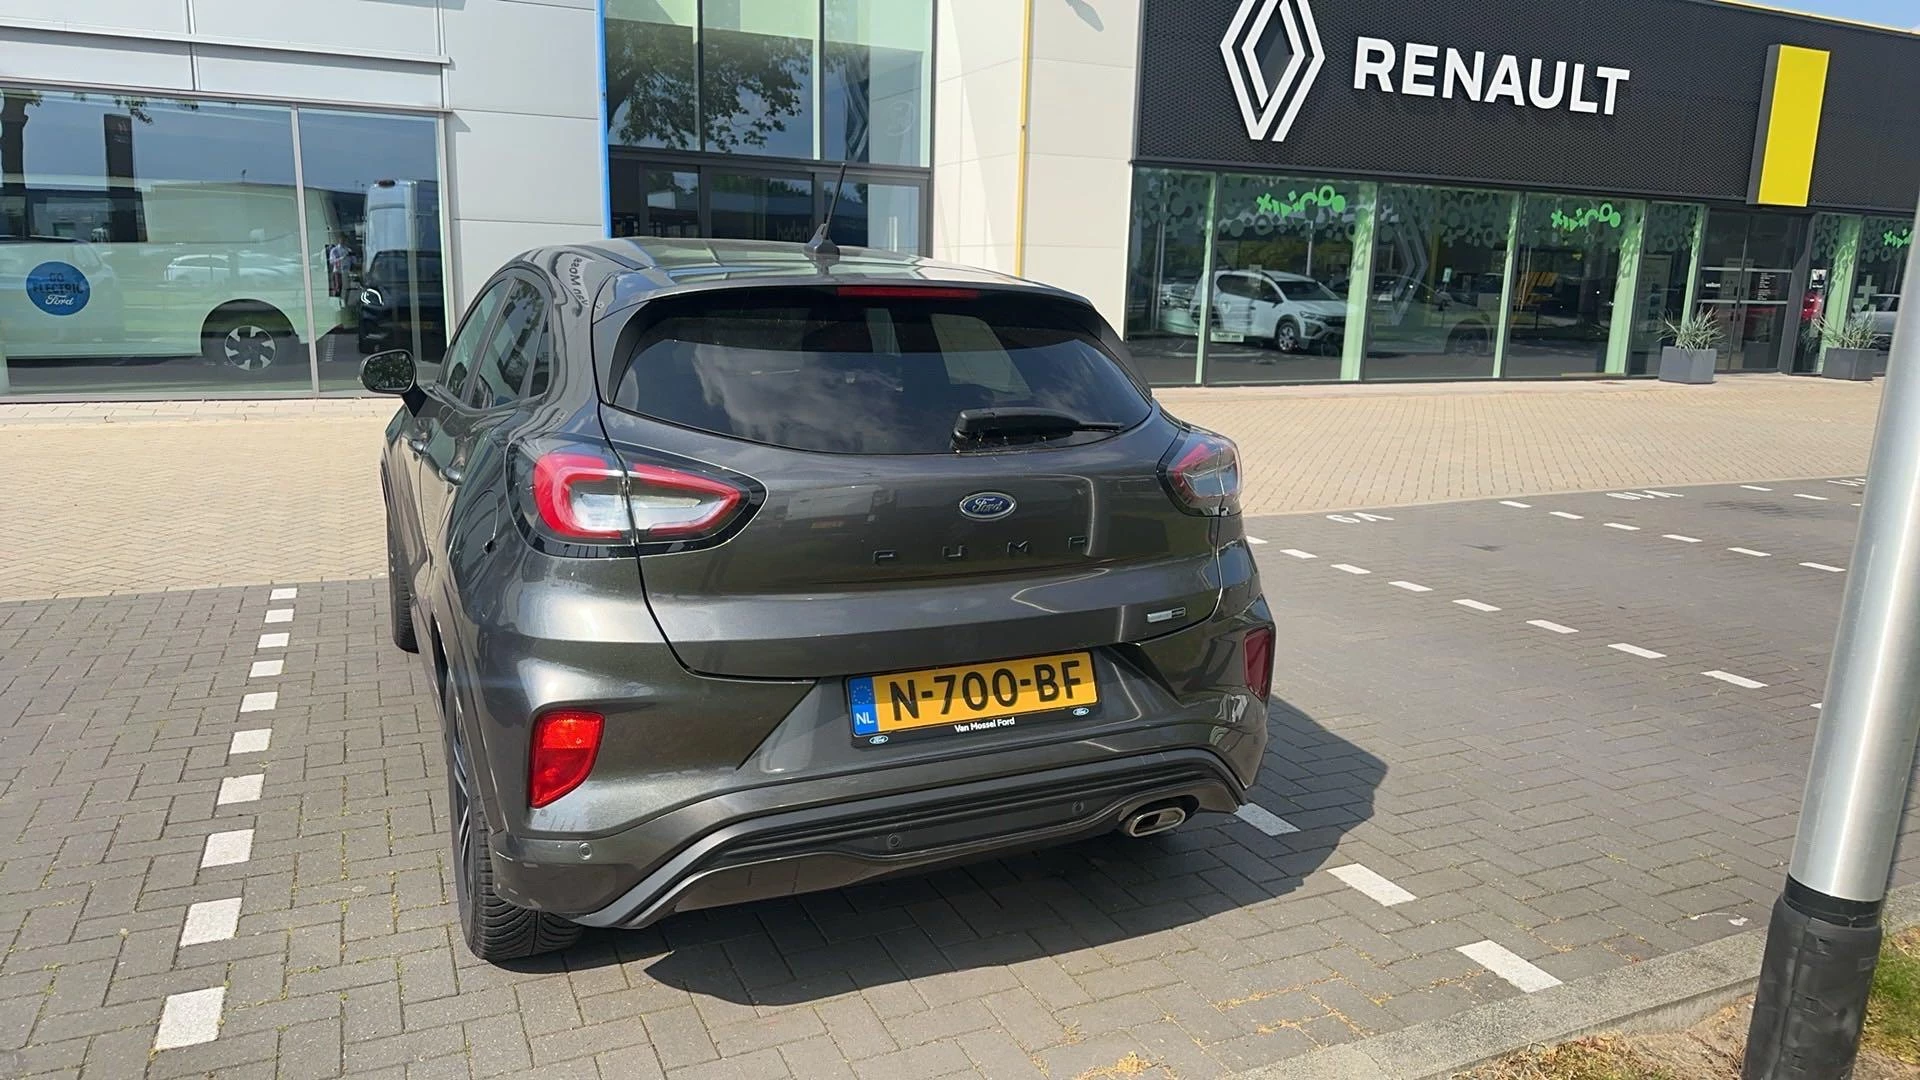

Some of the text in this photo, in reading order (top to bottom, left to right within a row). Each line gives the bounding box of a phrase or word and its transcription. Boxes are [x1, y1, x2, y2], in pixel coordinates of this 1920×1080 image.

[1353, 36, 1631, 115] RENAULT
[49, 272, 65, 282] GO
[45, 294, 75, 305] Ford
[971, 497, 1003, 512] Ford
[873, 535, 1088, 566] PUMA
[888, 660, 1082, 722] N-700-BF
[856, 711, 875, 726] NL
[954, 716, 1016, 733] Van Mossel Ford
